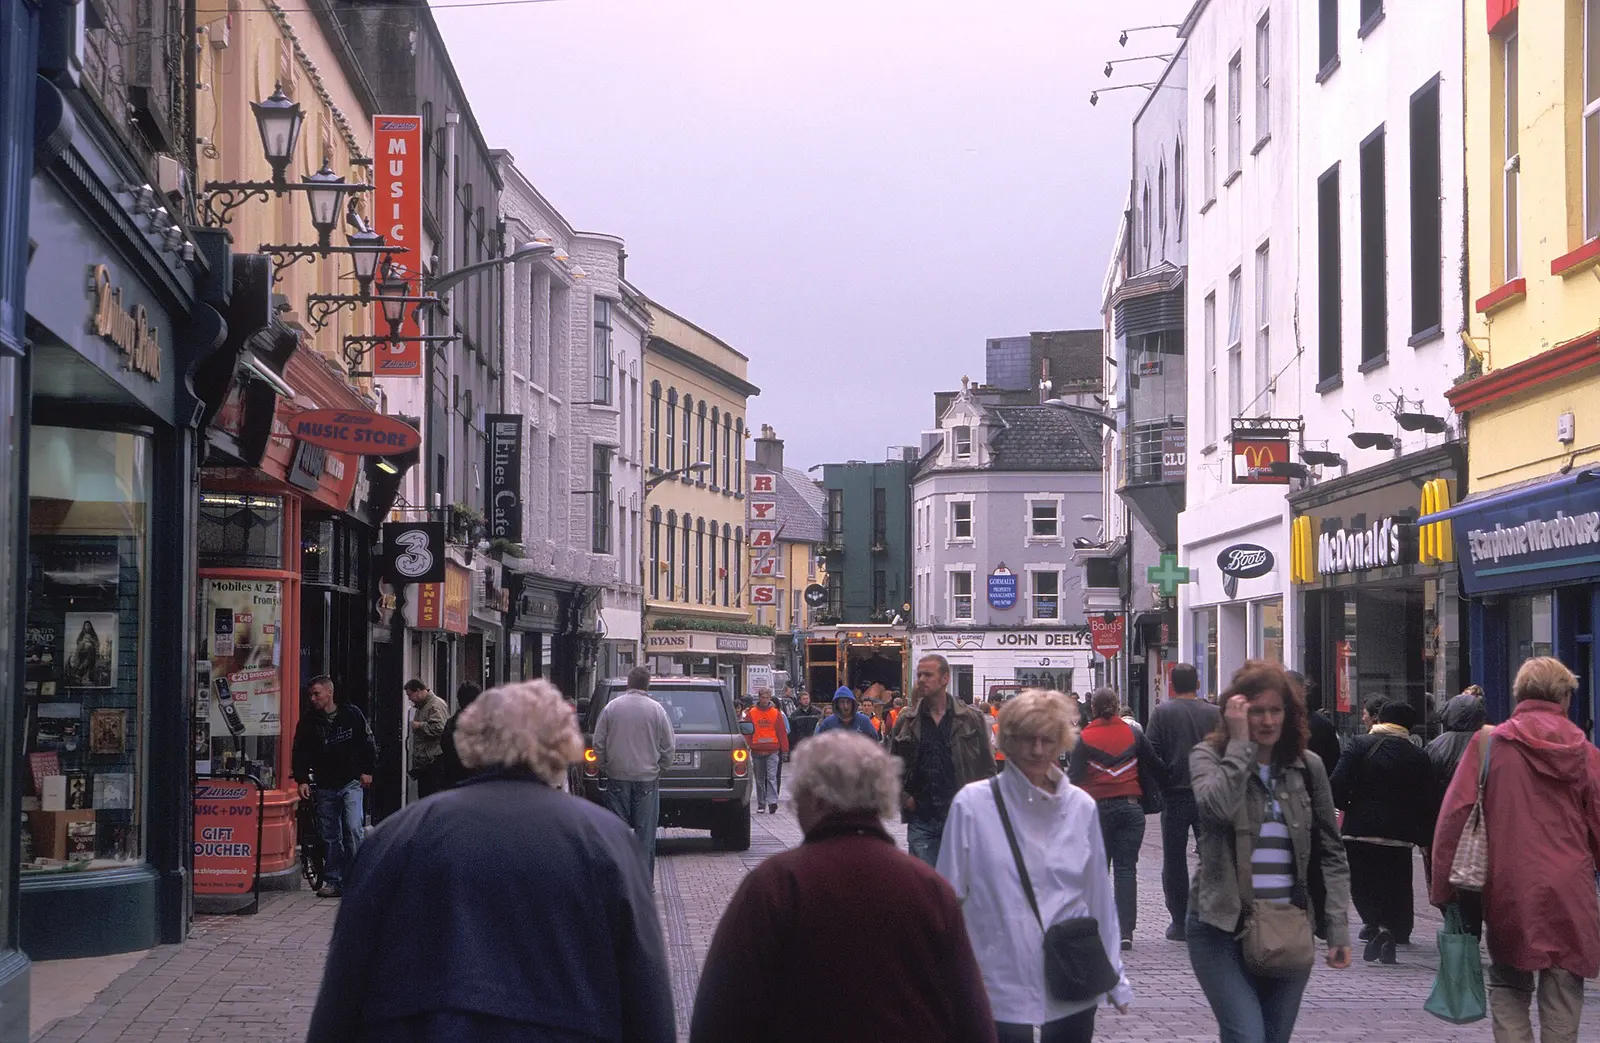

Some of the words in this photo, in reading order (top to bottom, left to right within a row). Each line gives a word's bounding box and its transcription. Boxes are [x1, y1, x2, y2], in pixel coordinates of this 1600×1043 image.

[387, 138, 407, 241] MUSIC
[297, 422, 349, 441] MUSIC
[354, 429, 409, 447] STORE
[495, 437, 517, 485] Elles
[495, 490, 517, 535] Cafe
[752, 476, 775, 602] RYANS
[1474, 522, 1527, 563] Carphone
[1525, 510, 1600, 552] Warehouse
[1318, 516, 1400, 575] McDonald's
[395, 530, 434, 577] 3
[1224, 550, 1267, 571] Boots
[211, 582, 252, 592] Mobiles
[253, 596, 273, 604] From
[239, 614, 251, 622] €49
[1092, 620, 1122, 633] Barry's
[650, 636, 685, 646] RYANS
[997, 633, 1038, 646] JOHN
[231, 673, 248, 682] €20
[249, 670, 276, 678] DISCOUNT
[194, 786, 248, 800] ZHIVAGO
[194, 805, 218, 816] USIC
[229, 806, 252, 816] DVD
[202, 828, 234, 841] GIFT
[194, 844, 251, 857] OUCHER
